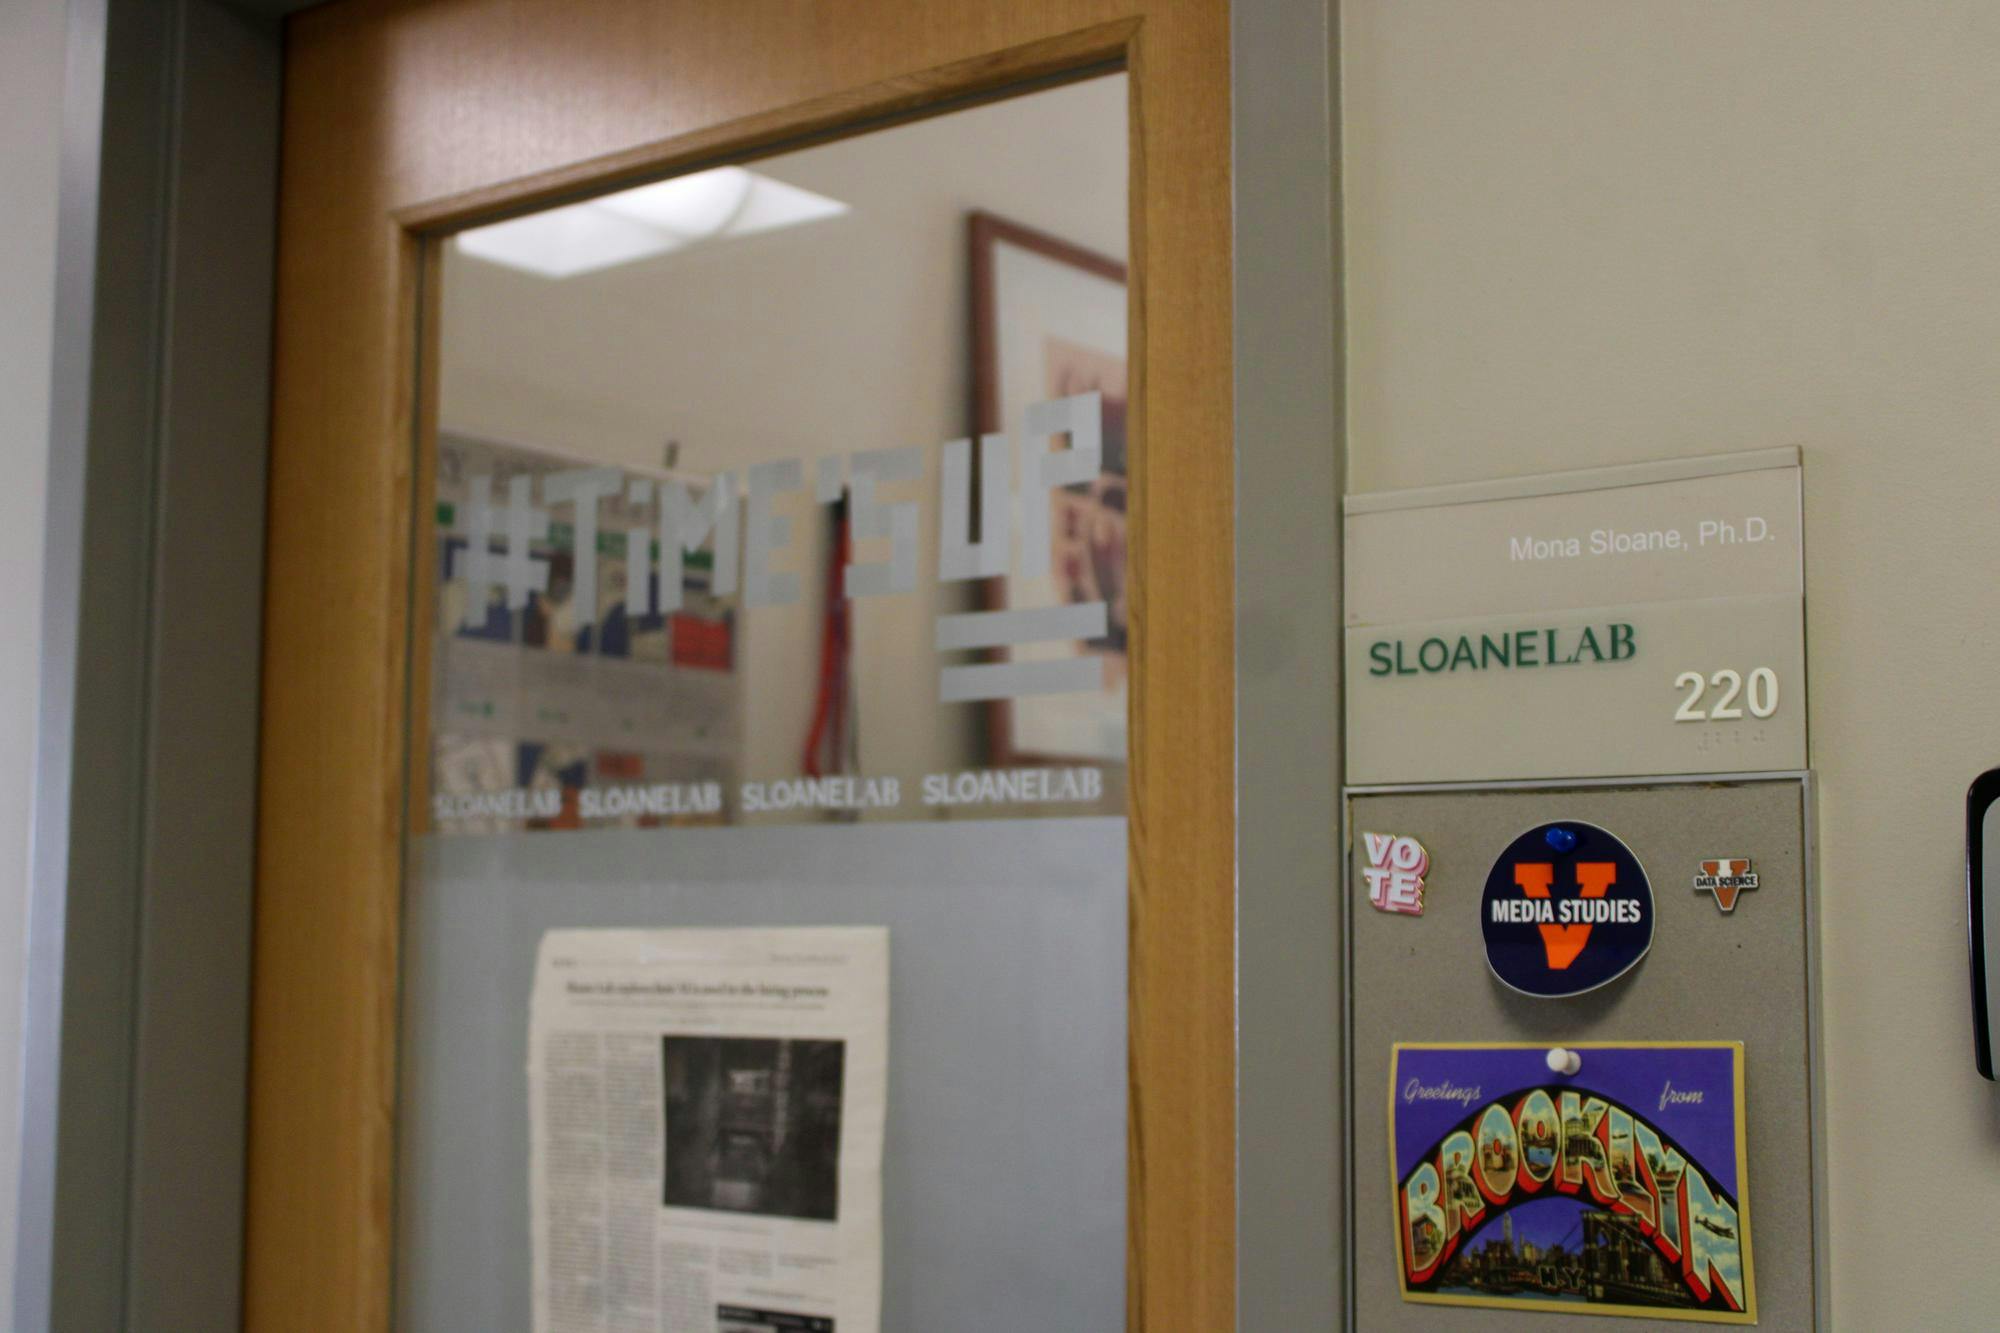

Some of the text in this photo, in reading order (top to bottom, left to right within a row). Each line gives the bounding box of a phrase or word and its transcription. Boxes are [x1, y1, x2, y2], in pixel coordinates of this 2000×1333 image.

[1510, 516, 1776, 561] Mona Sloane, Ph.D.
[1368, 623, 1637, 677] SLOANELAB
[1673, 667, 1780, 722] 220
[1696, 875, 1757, 887] DATA SCIENCE
[1492, 899, 1642, 923] MEDIA STUDIES
[1405, 1078, 1704, 1111] Greetings from
[1402, 1088, 1745, 1312] BROOKLYN
